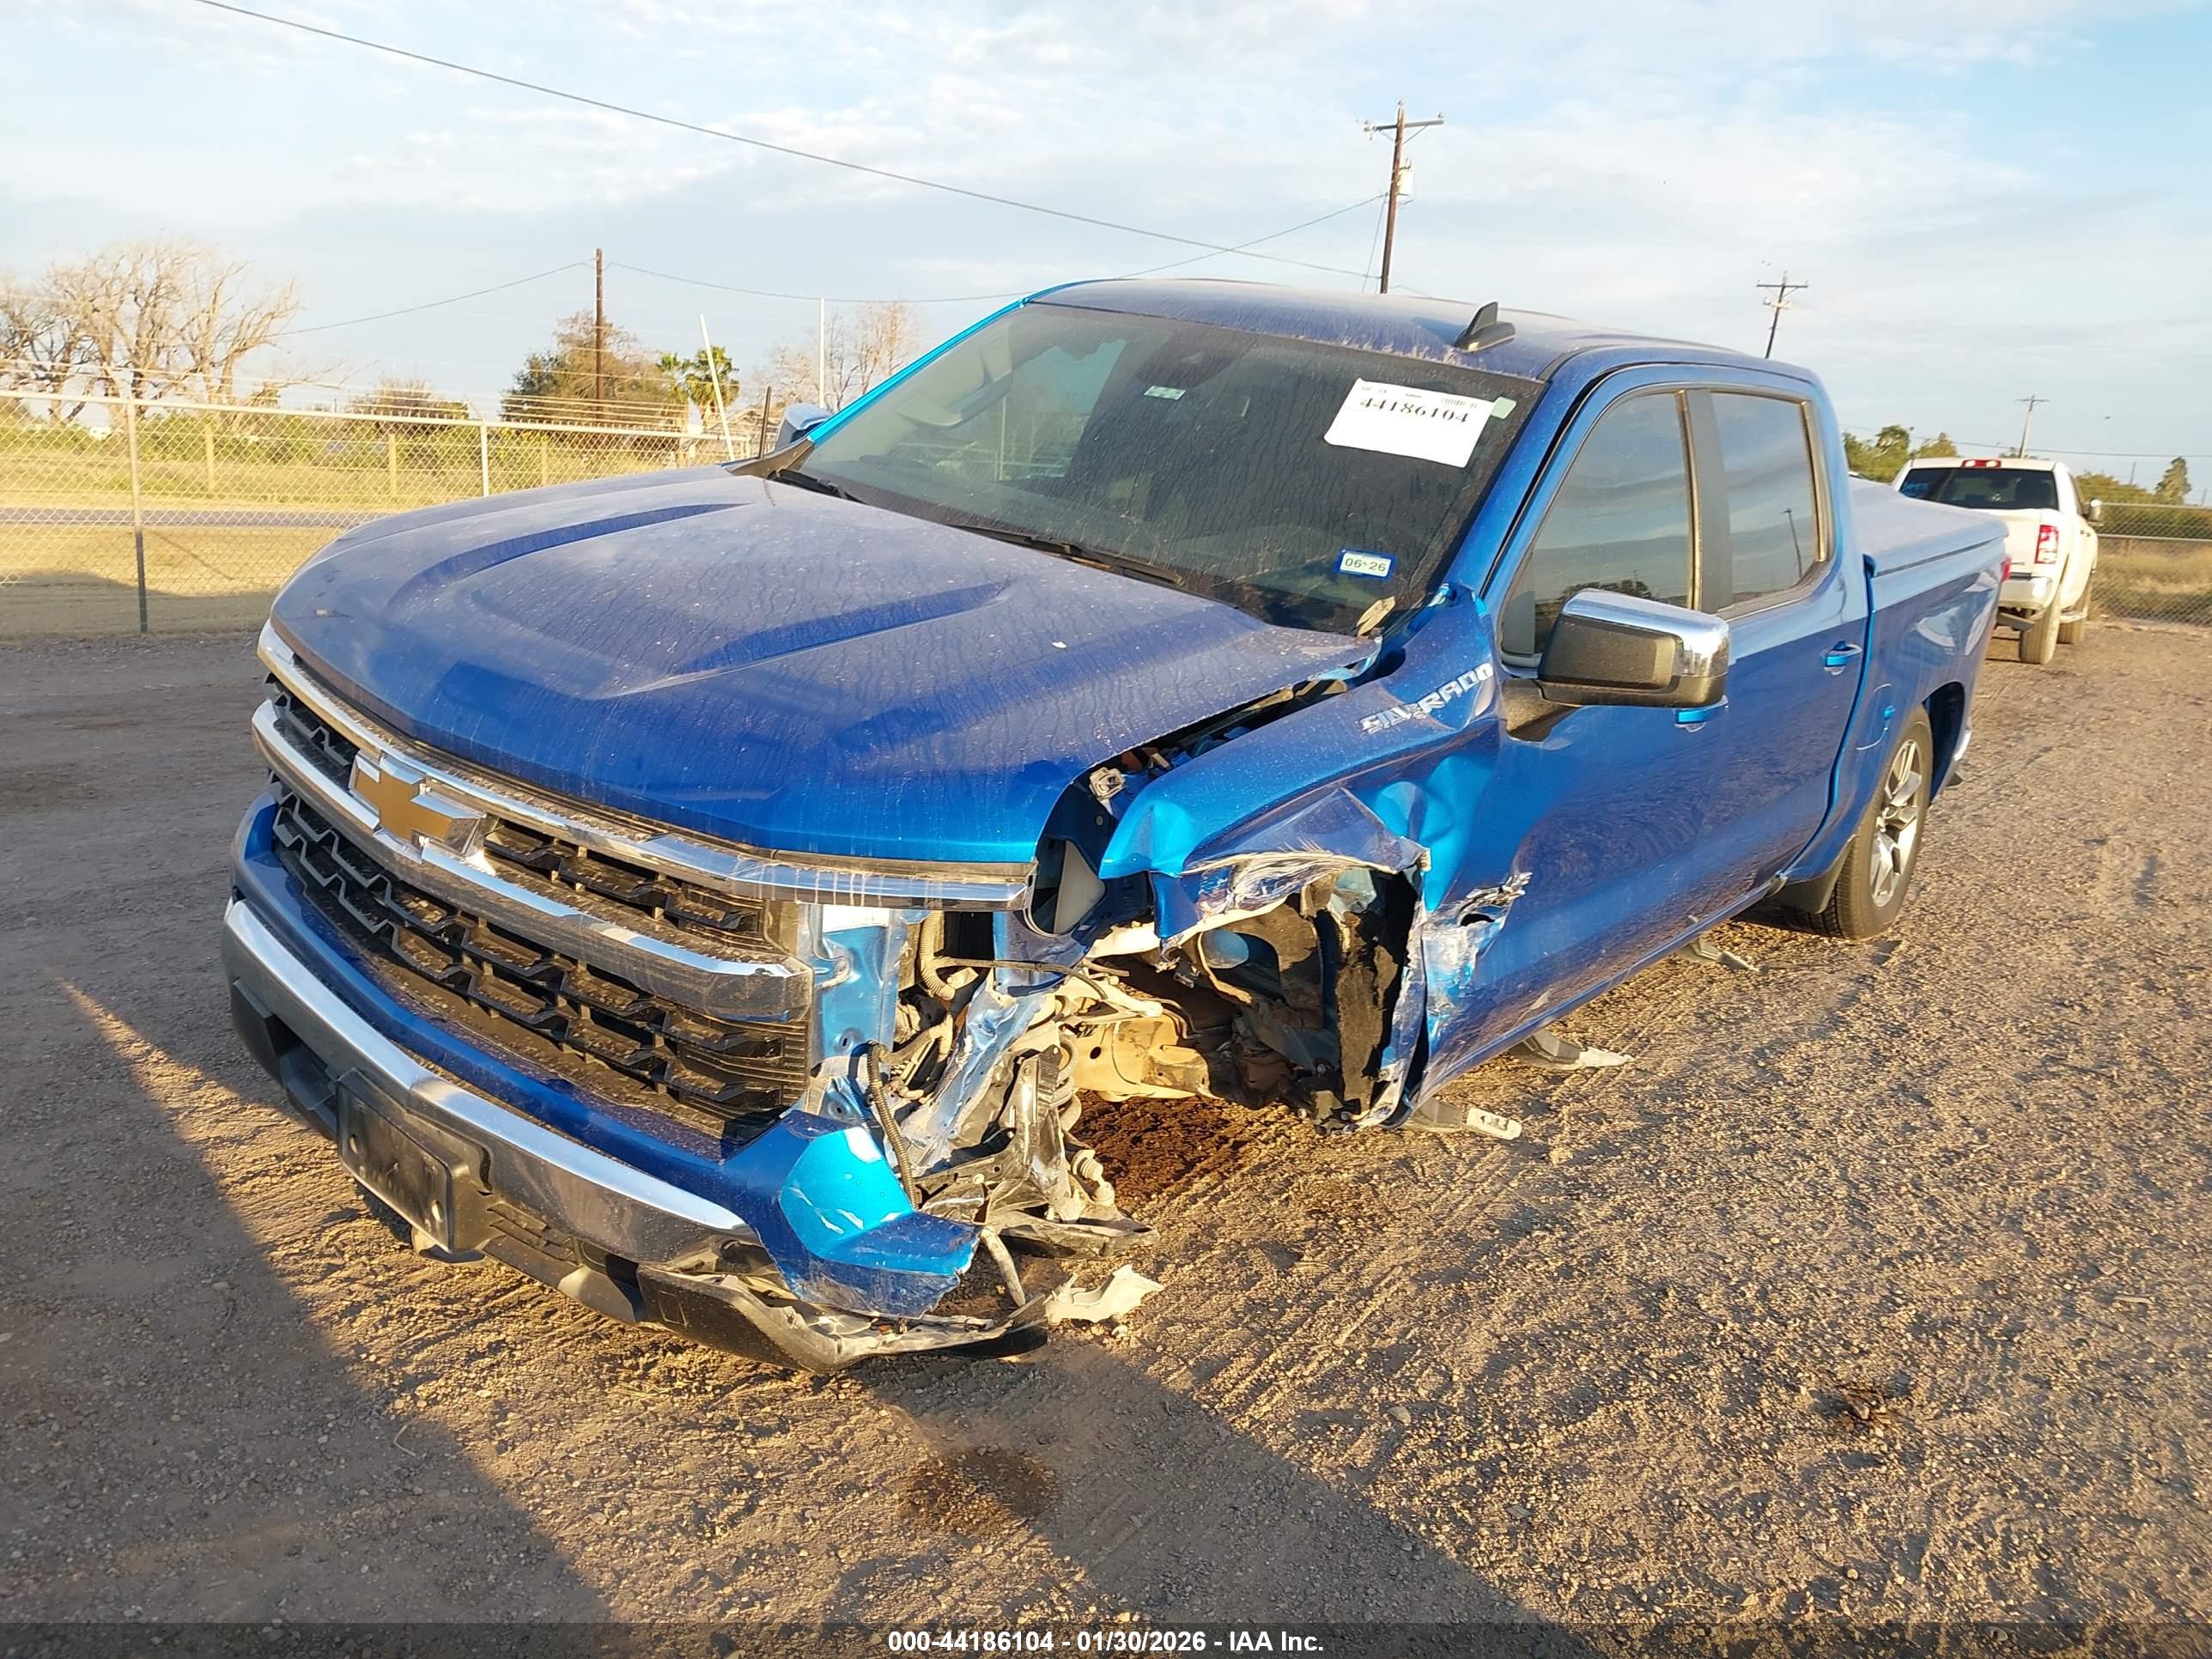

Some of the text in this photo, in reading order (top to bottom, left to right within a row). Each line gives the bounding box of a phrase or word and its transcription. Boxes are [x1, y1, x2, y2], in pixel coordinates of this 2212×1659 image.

[1359, 398, 1469, 423] 44186104
[1345, 558, 1387, 572] 06 26
